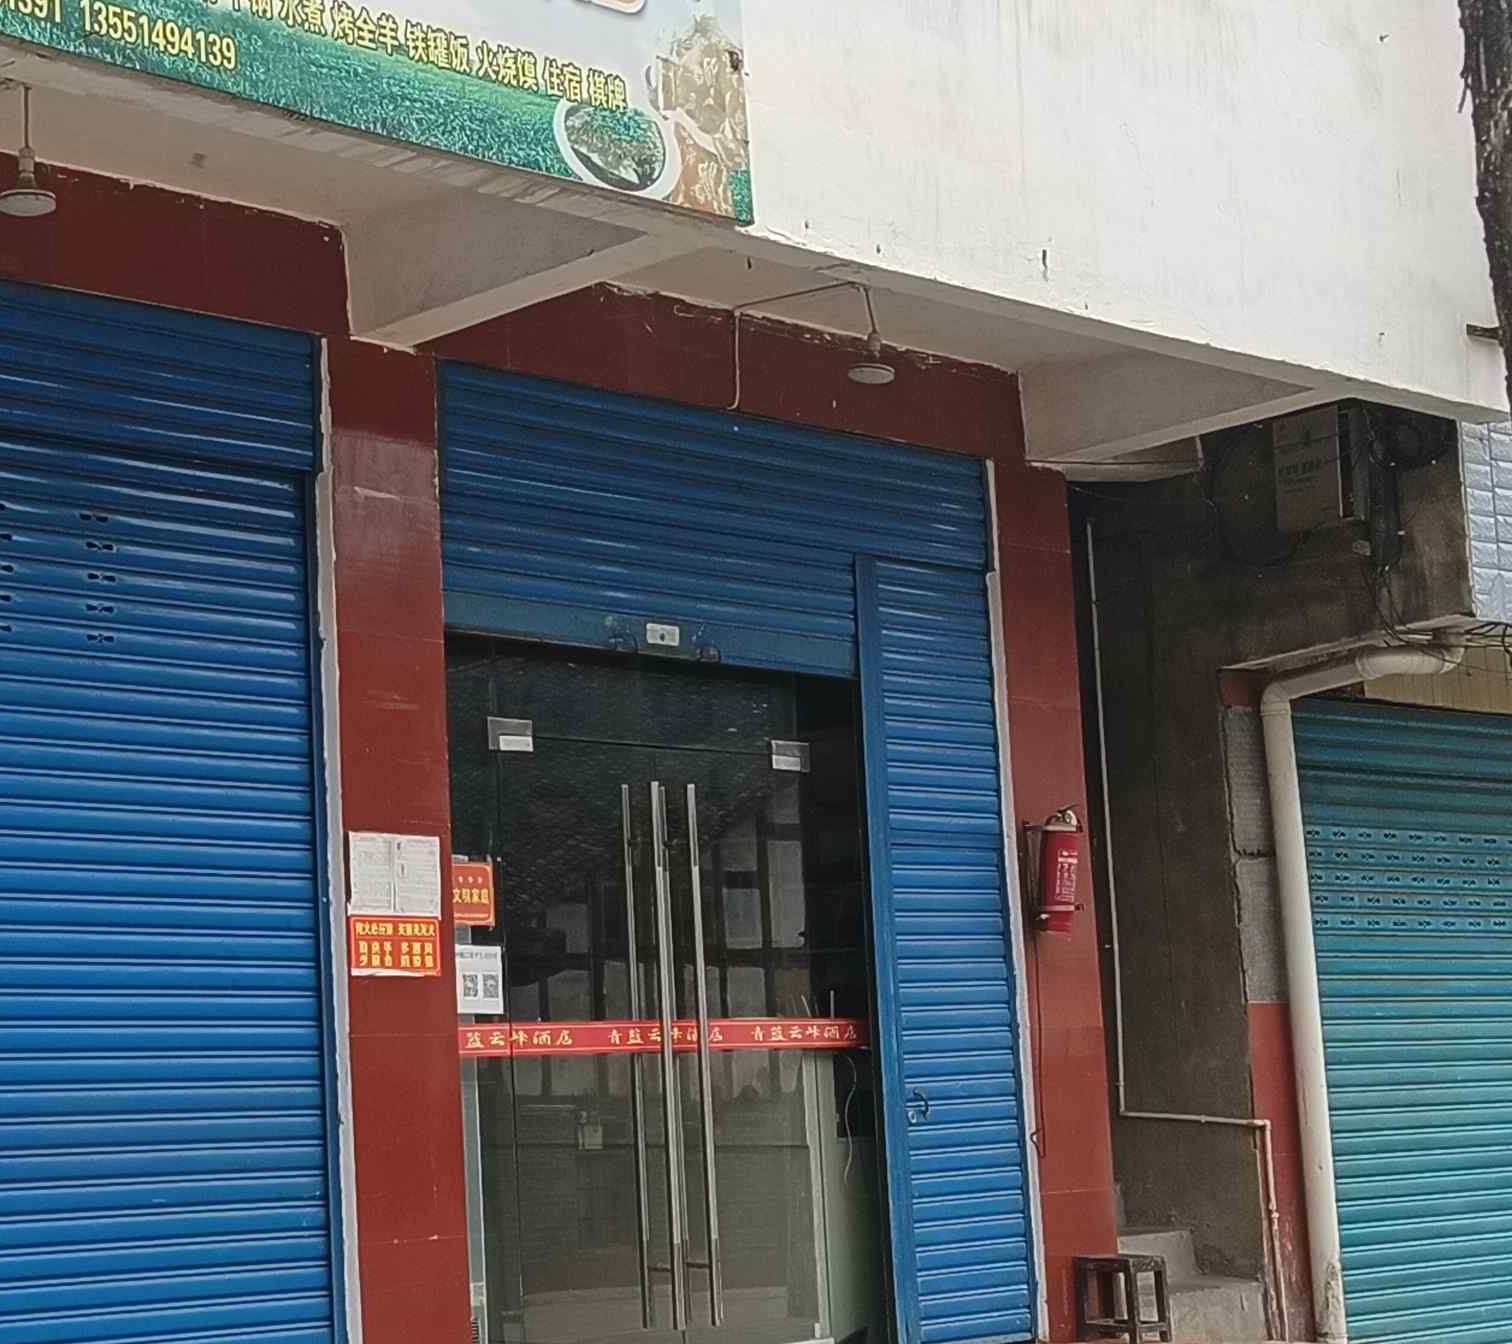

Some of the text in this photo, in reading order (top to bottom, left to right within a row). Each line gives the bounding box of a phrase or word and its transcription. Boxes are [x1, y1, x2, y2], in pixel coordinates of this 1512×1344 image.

[331, 0, 399, 55] 烤全羊
[405, 20, 472, 74] 铁罐饭
[543, 57, 582, 103] 住宿
[588, 67, 629, 113] 棋牌
